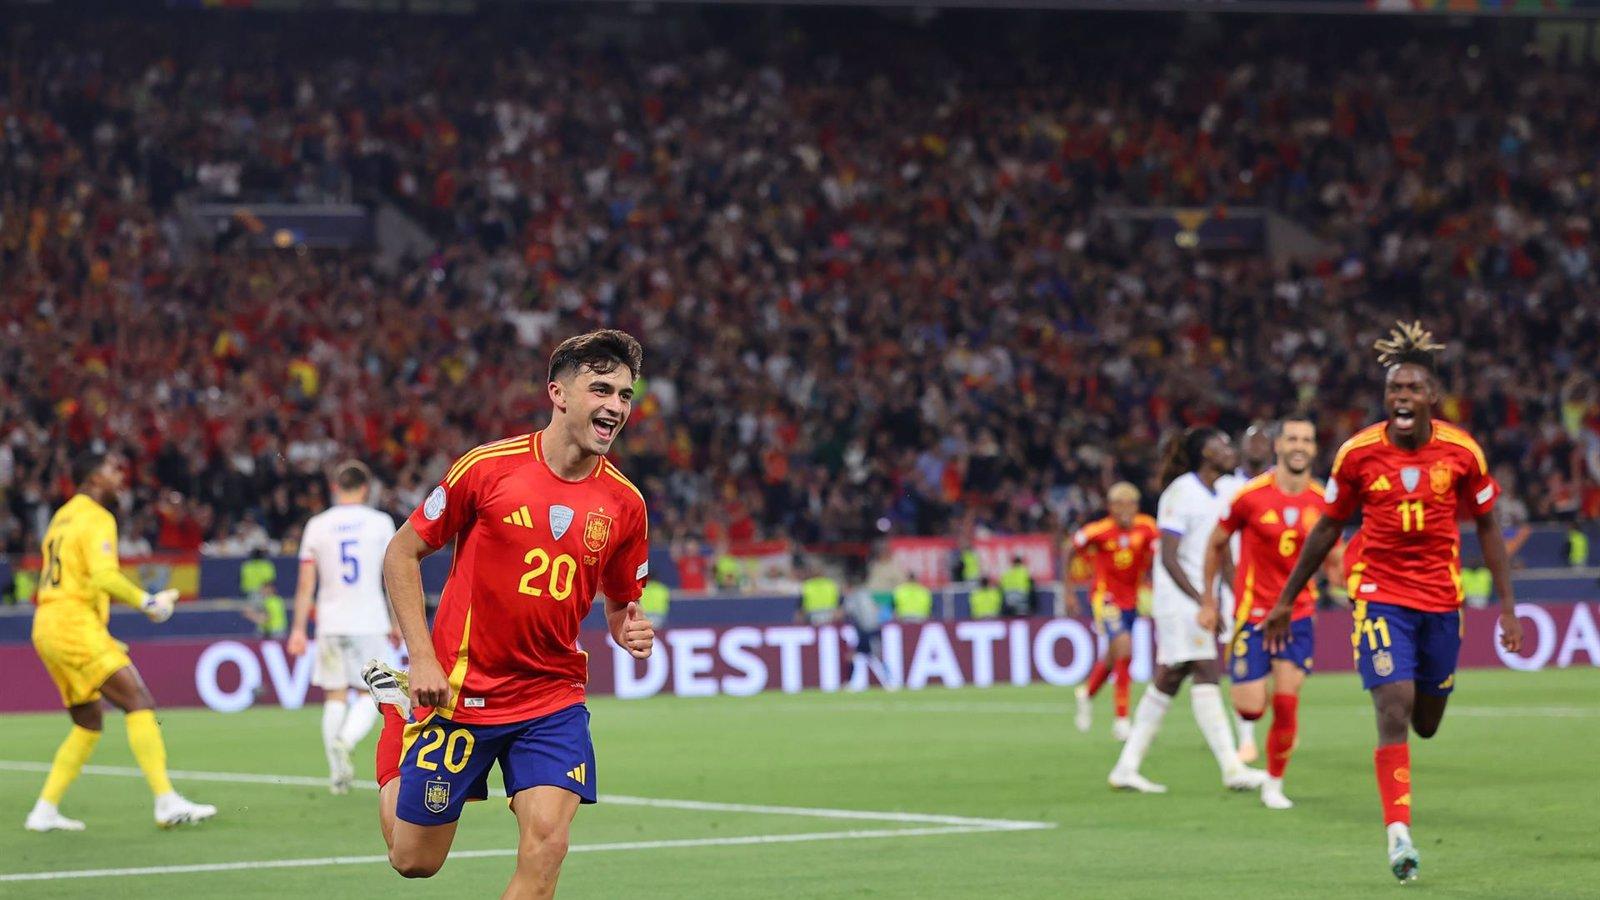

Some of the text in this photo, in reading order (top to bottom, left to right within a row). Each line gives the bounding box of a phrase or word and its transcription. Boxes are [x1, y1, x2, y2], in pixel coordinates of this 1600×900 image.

[1397, 500, 1424, 532] 11
[340, 540, 359, 584] 5
[1279, 529, 1297, 557] 6
[518, 547, 577, 601] 20
[1363, 616, 1391, 650] 11
[195, 640, 318, 713] OV
[416, 725, 475, 773] 20
